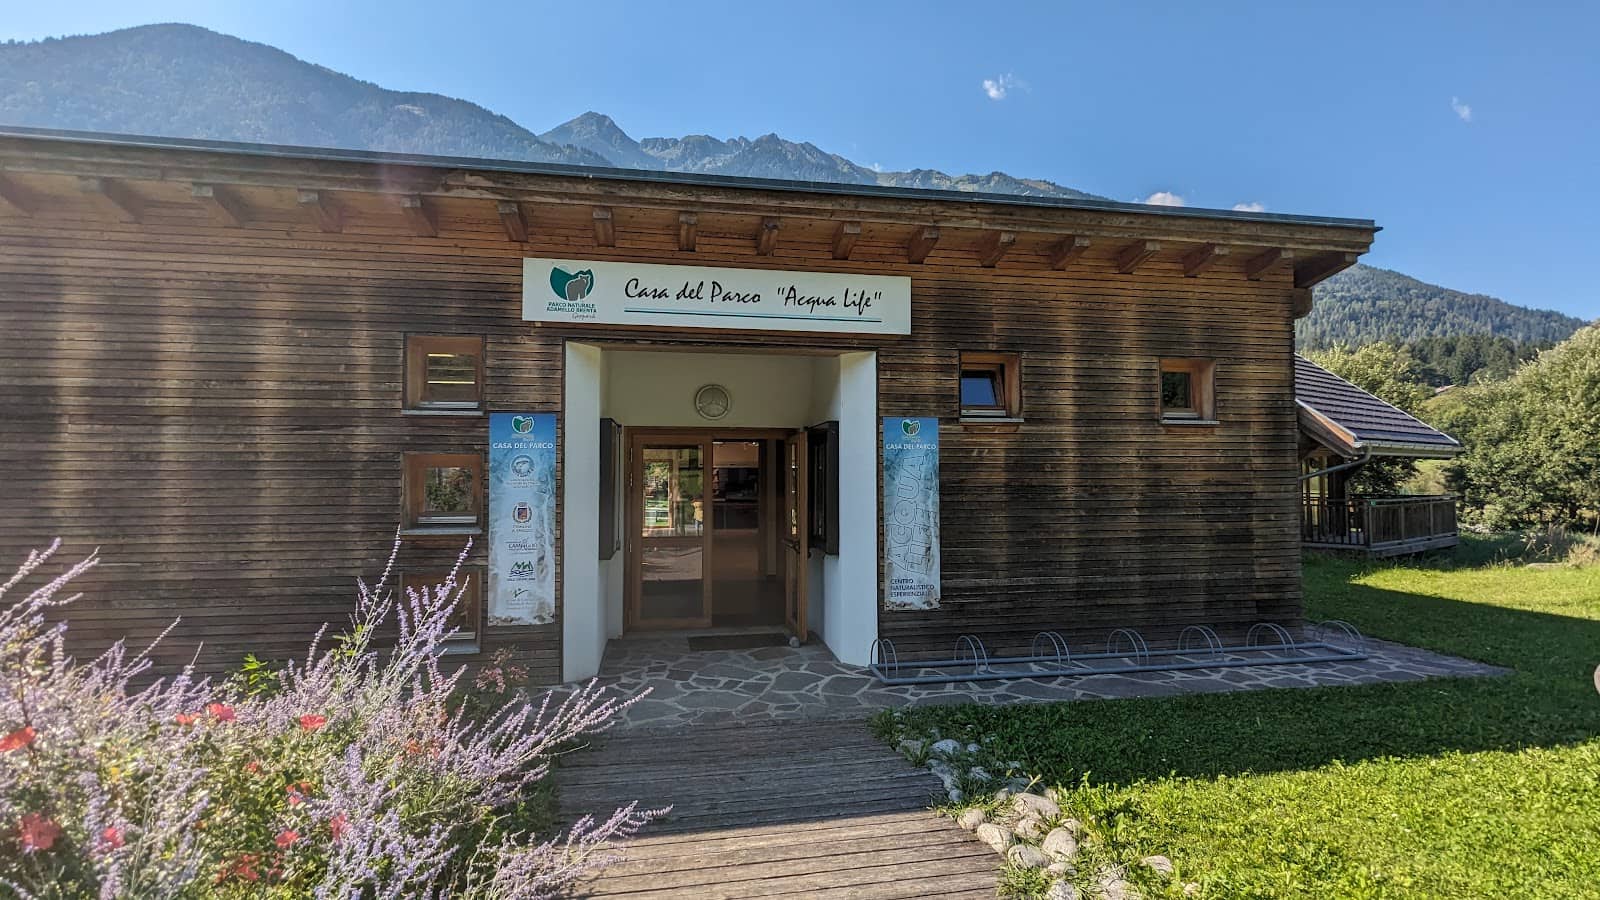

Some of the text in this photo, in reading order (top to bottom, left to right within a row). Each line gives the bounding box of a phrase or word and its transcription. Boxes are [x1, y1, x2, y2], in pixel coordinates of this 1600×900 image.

[624, 278, 882, 316] Casa del Parco "Acqua Life"
[887, 455, 926, 570] ACQUA
